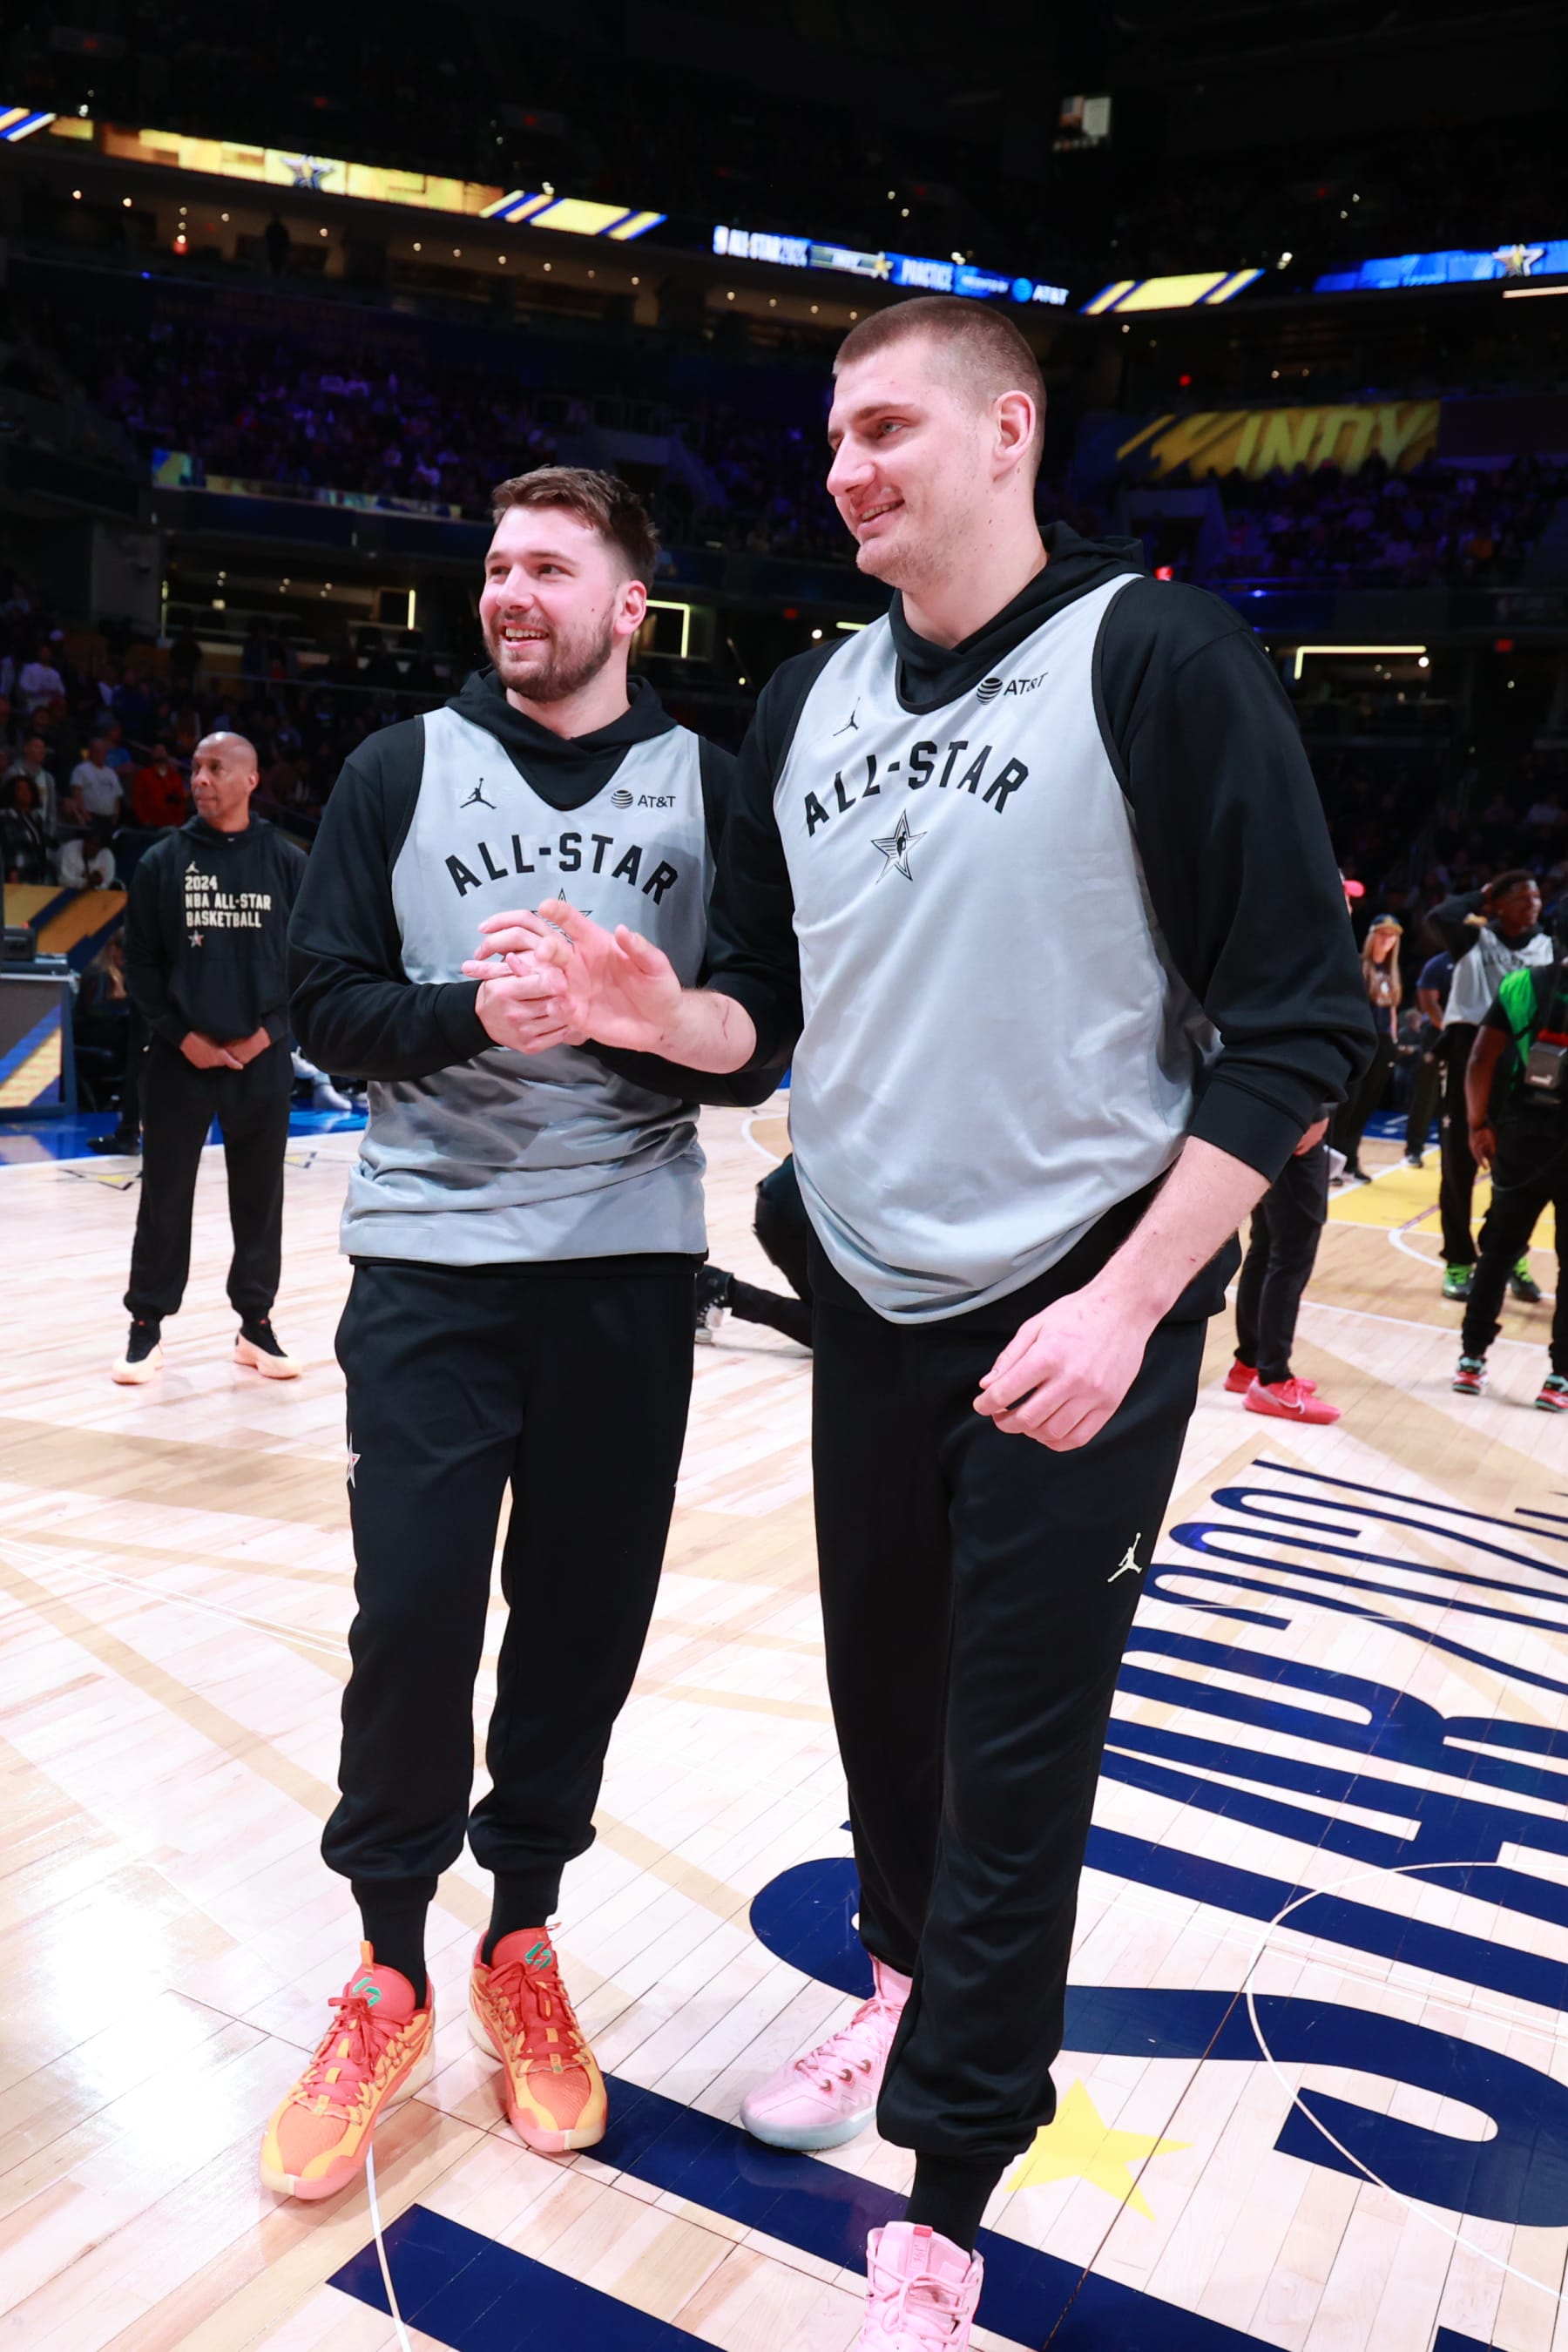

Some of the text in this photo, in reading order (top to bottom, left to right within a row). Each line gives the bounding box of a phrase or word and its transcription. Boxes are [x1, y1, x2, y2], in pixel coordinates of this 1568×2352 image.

[1233, 405, 1434, 477] INDY
[1004, 672, 1049, 697] AT&T
[803, 740, 1030, 838] ALL-STAR
[637, 794, 676, 808] AT&T
[444, 832, 679, 905] ALL-STAR
[185, 875, 218, 891] 2024
[185, 892, 210, 909] NBA
[186, 909, 262, 928] BASKETBALL
